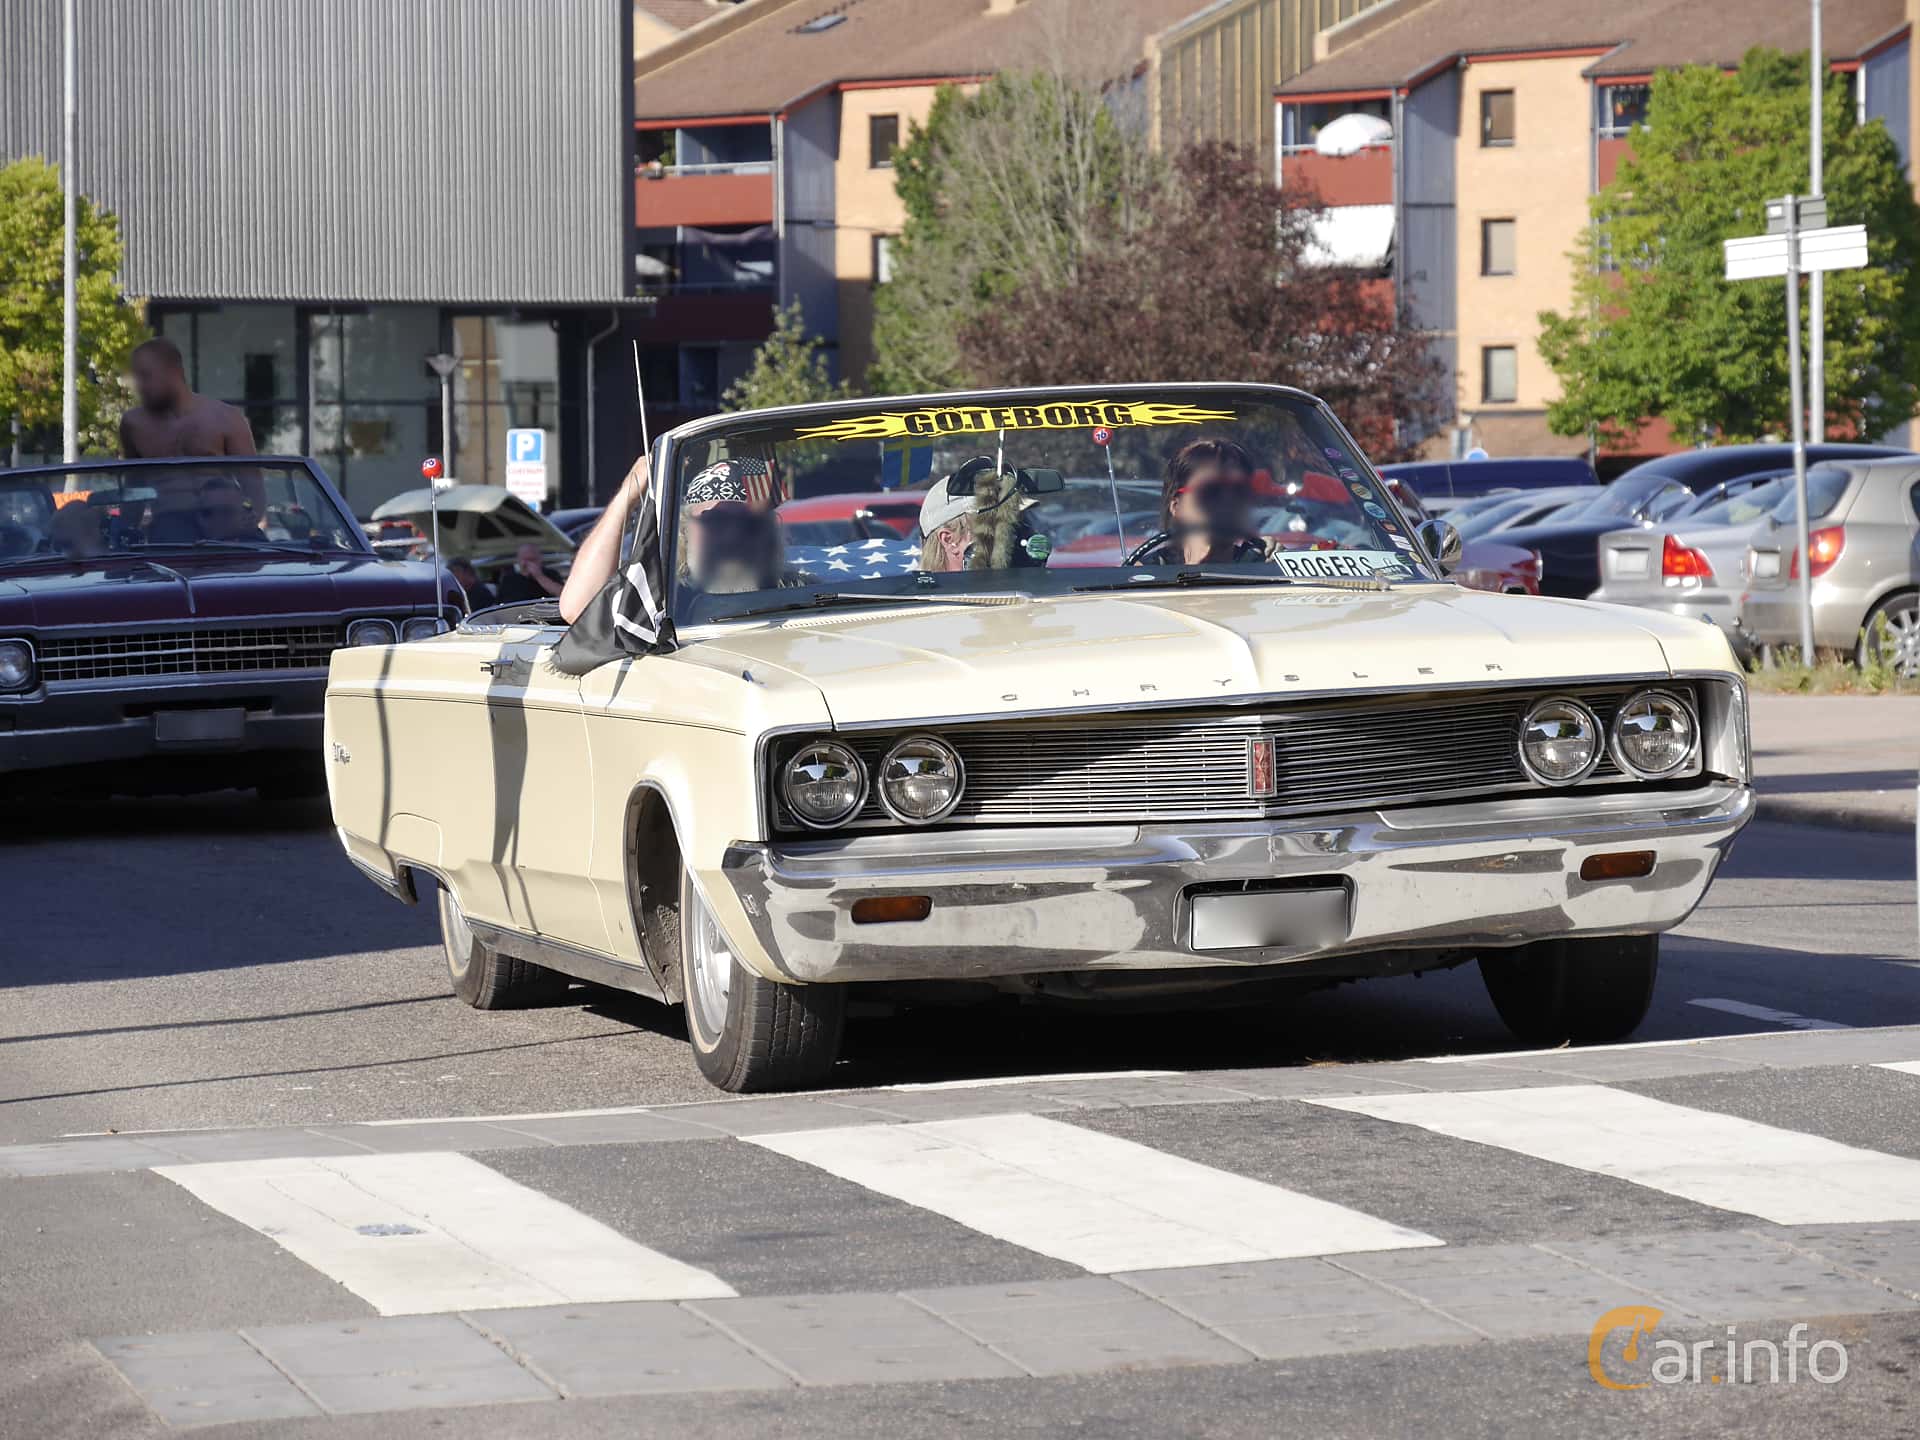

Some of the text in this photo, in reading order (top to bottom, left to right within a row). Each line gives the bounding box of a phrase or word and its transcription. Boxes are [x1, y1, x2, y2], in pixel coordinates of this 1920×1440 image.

[516, 433, 536, 460] P
[1284, 556, 1375, 577] ROGERS
[1001, 663, 1503, 701] CHRYSLER
